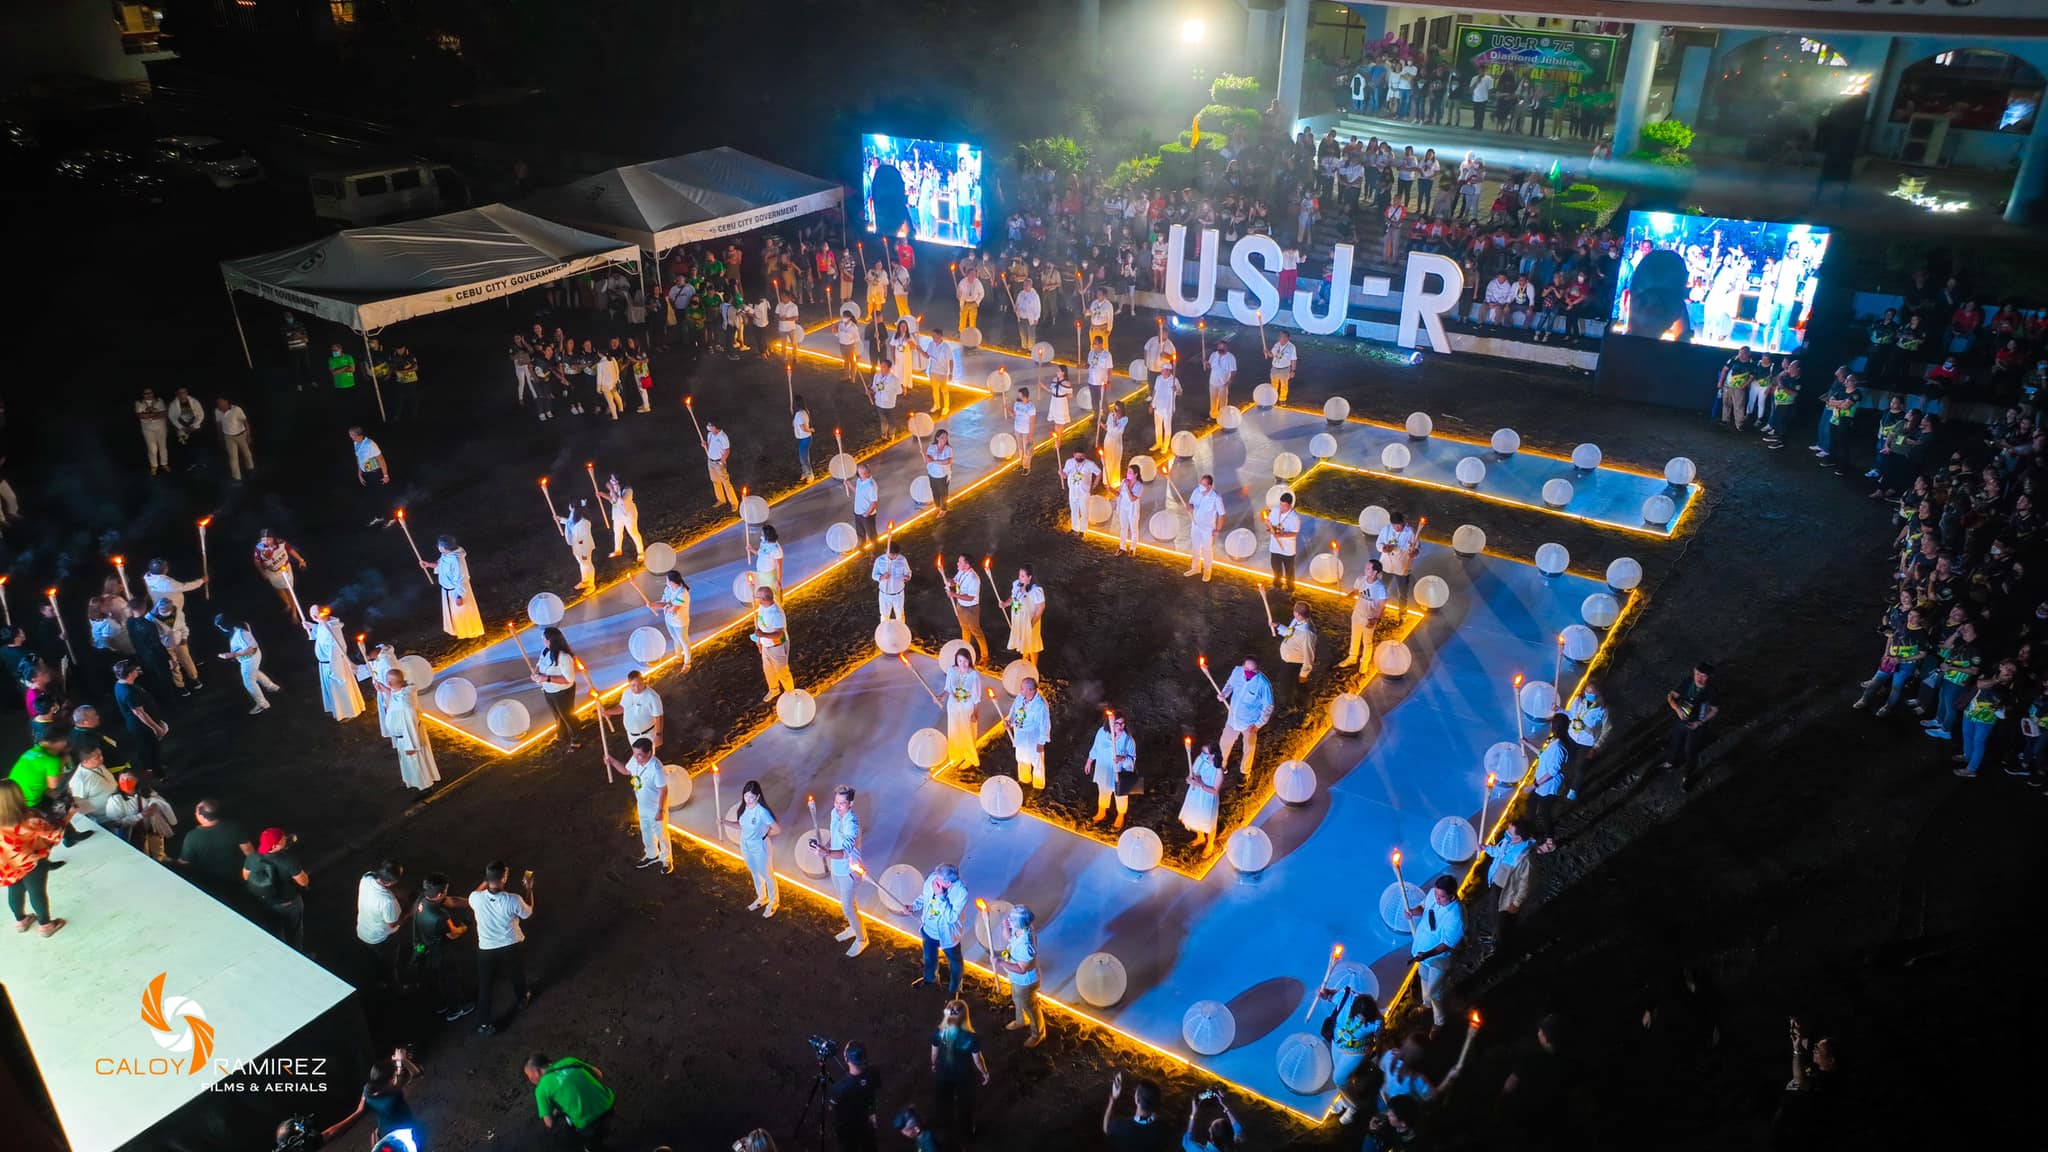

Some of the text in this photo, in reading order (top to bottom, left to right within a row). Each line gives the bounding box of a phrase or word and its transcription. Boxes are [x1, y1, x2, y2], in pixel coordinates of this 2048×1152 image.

[1553, 39, 1575, 55] 75
[1490, 51, 1581, 67] Diamond Jubilee
[718, 205, 798, 233] CEBU CITY GOVERNMENT
[456, 286, 483, 301] CEBU
[485, 280, 508, 293] CITY
[1165, 223, 1464, 354] USJ-R
